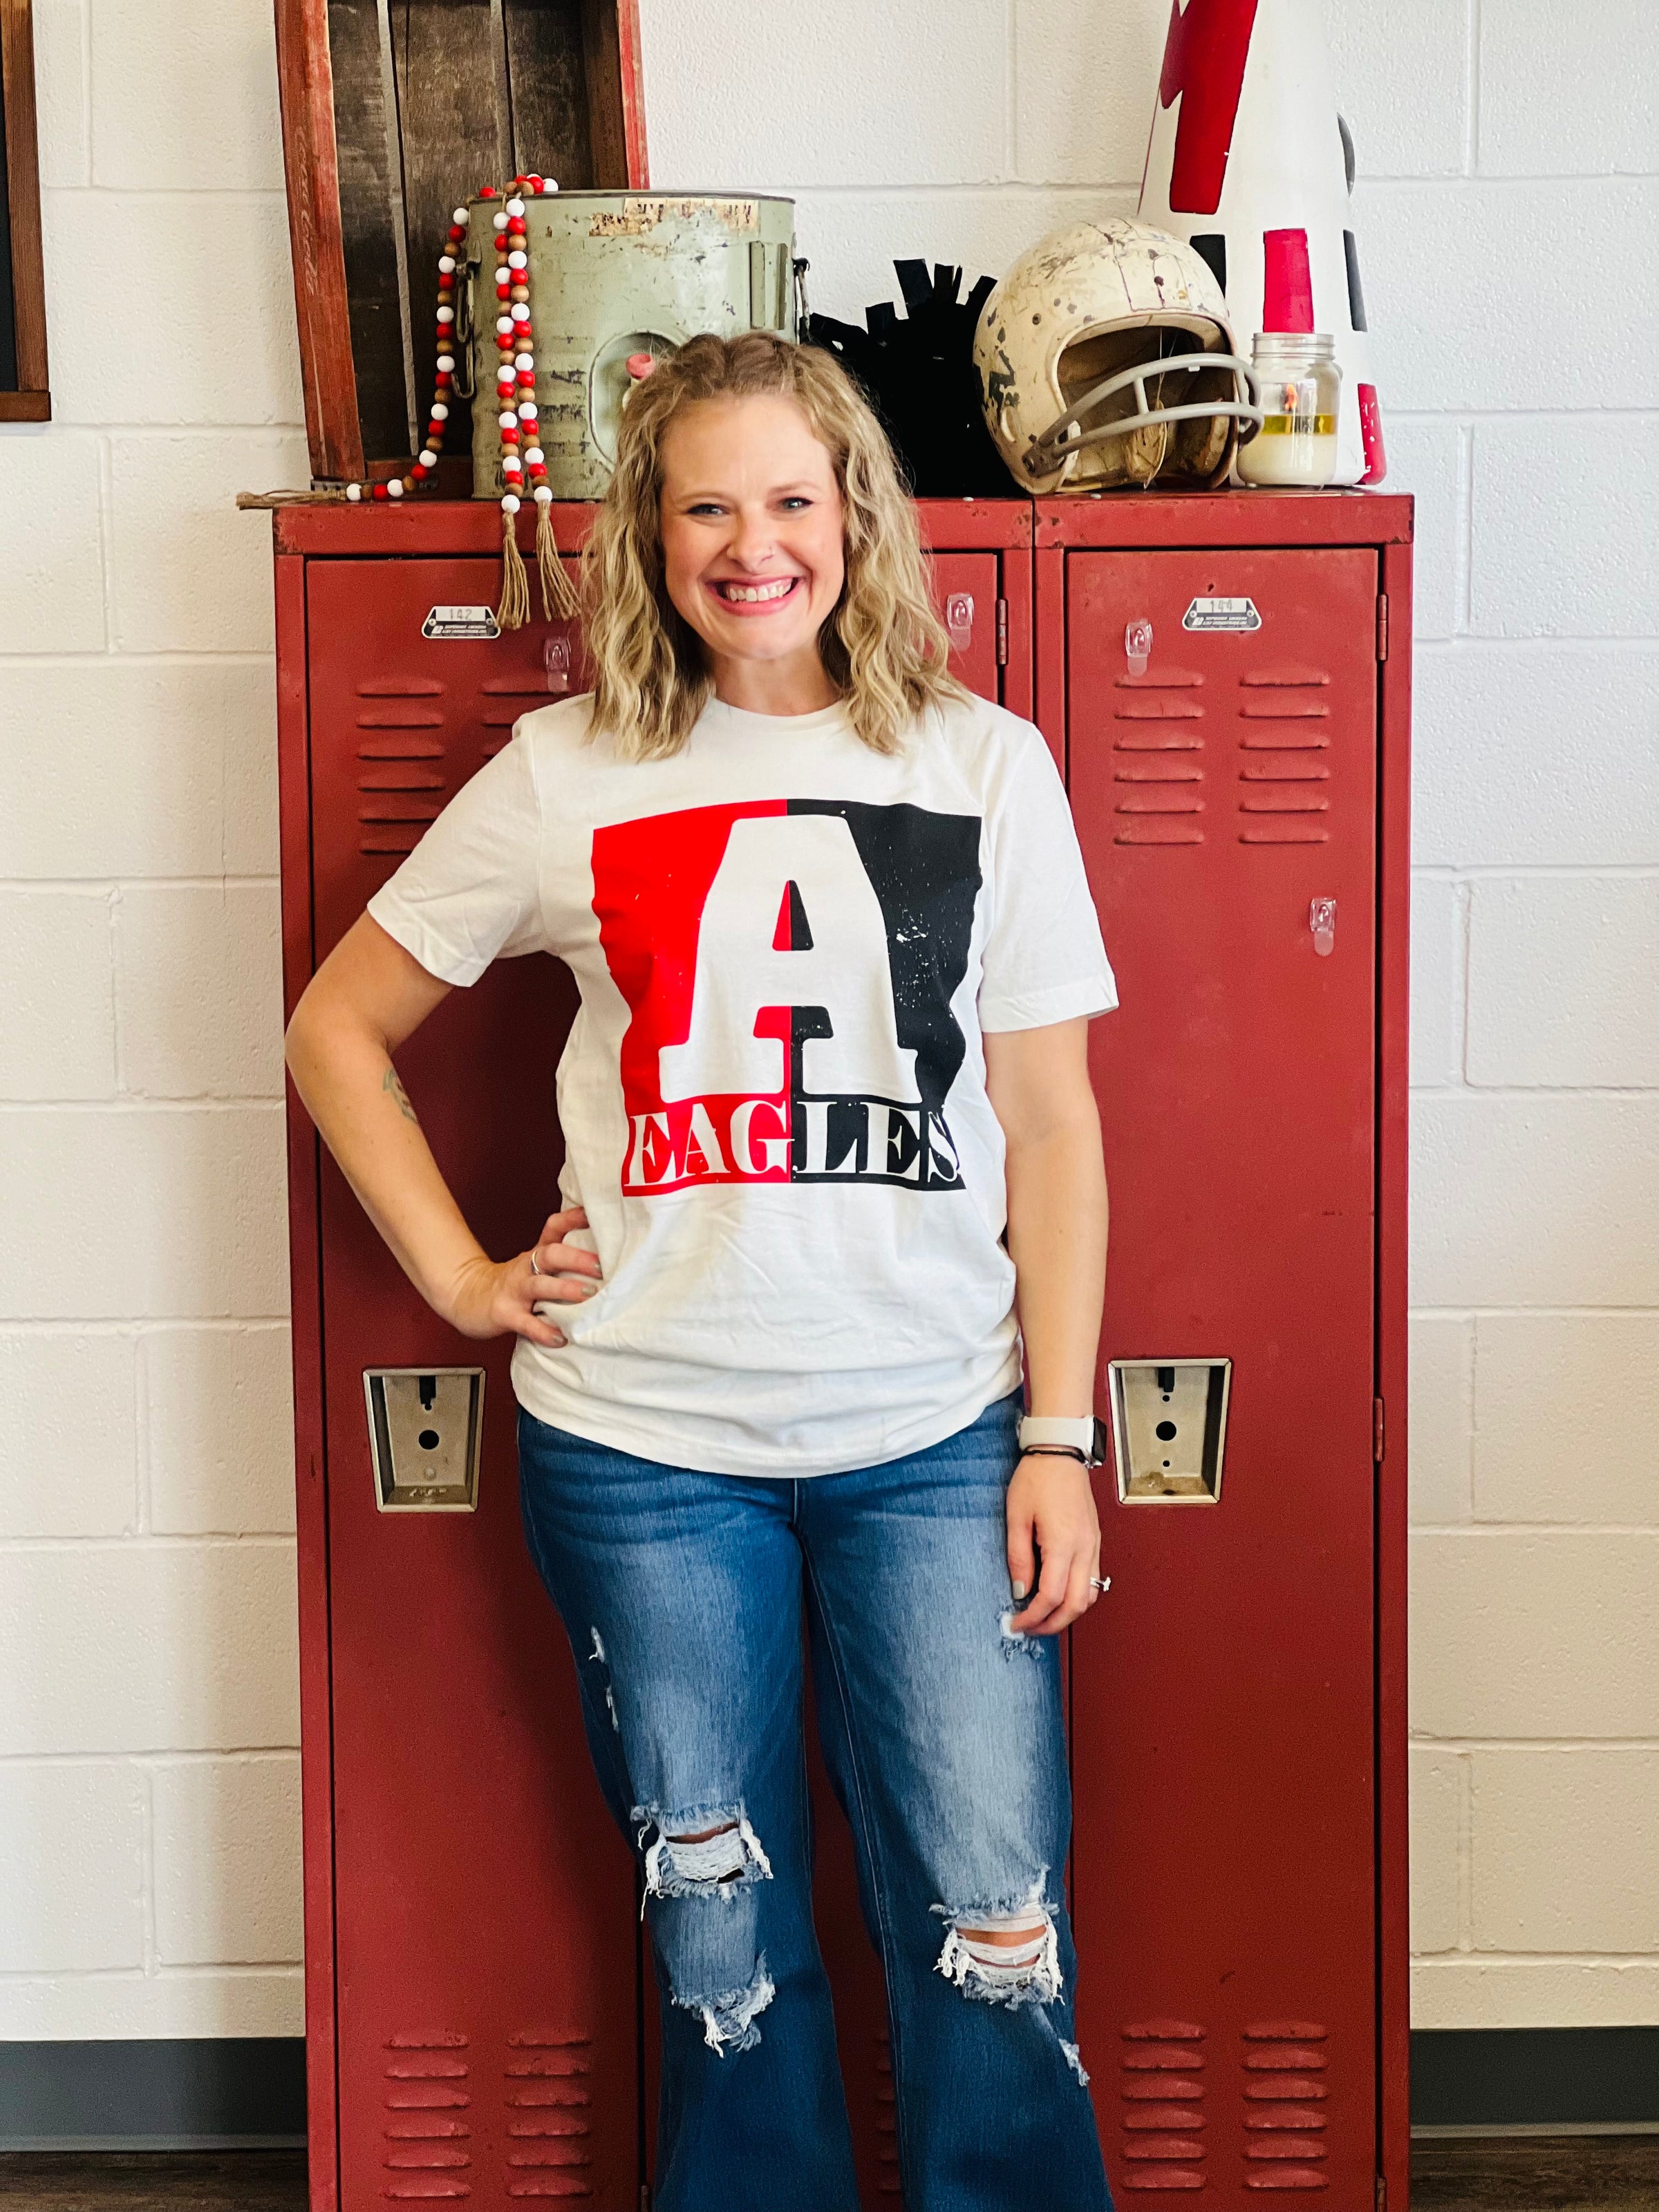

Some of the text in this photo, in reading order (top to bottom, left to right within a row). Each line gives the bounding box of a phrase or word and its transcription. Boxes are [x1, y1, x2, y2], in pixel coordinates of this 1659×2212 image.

[449, 608, 472, 621] 142
[659, 815, 921, 1104] A
[624, 1100, 960, 1187] EAGLES
